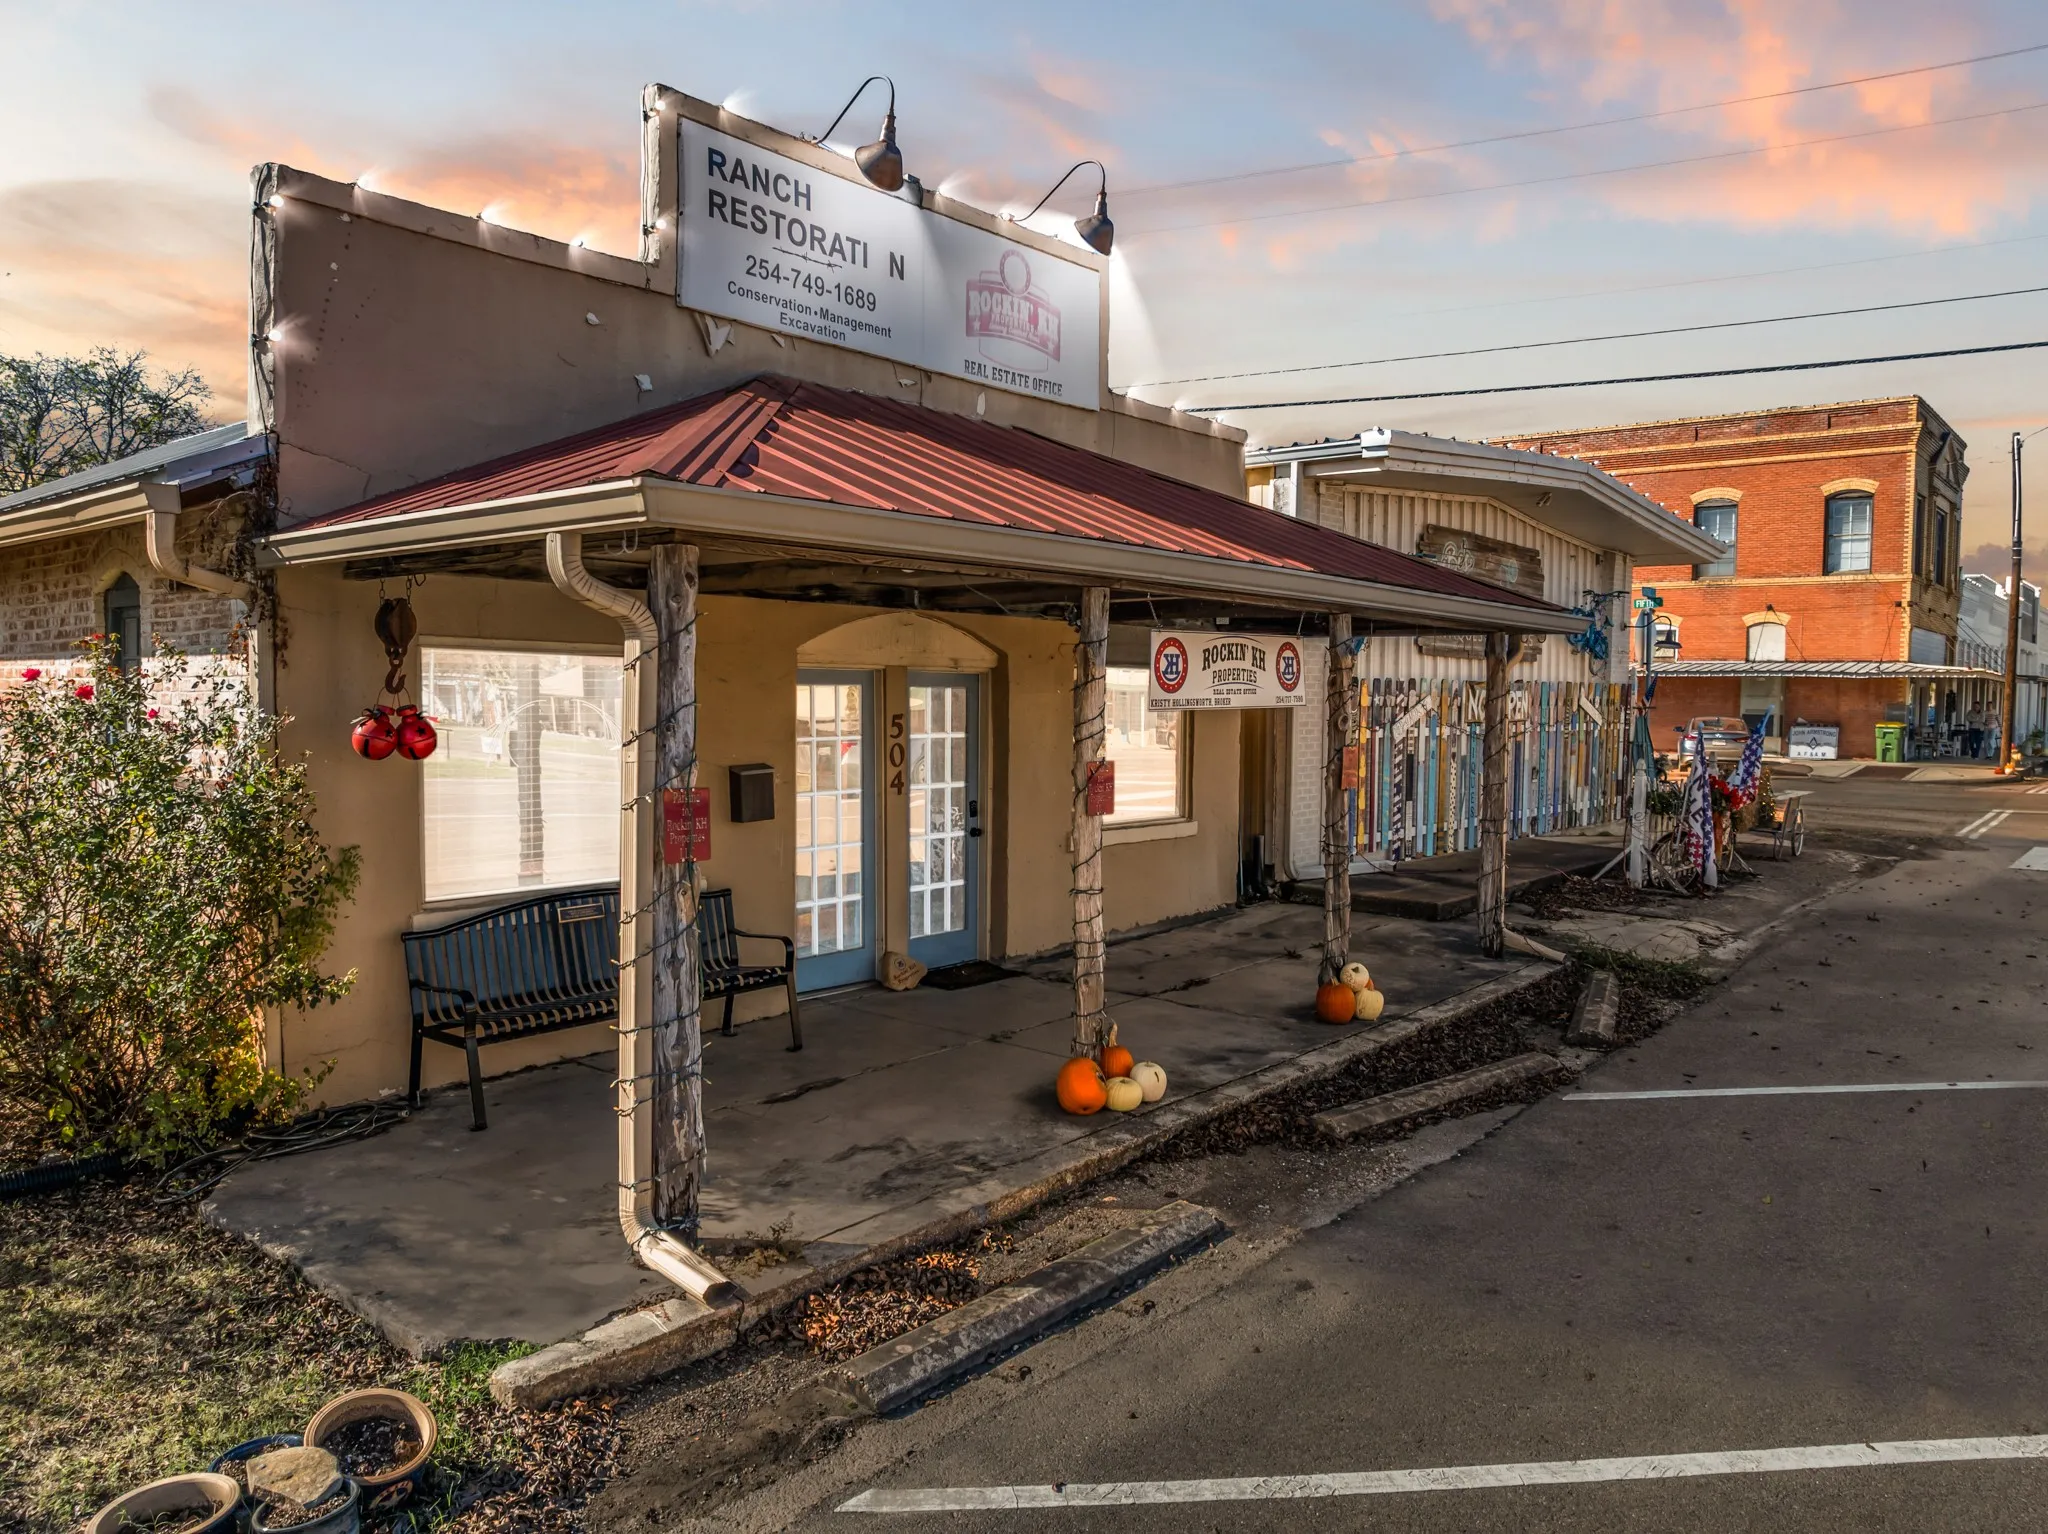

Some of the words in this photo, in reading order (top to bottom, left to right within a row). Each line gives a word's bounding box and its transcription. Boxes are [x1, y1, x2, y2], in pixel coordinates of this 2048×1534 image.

[707, 146, 811, 212] RANCH
[745, 254, 877, 312] 254-749-1689
[727, 280, 812, 316] Conservation
[819, 307, 892, 339] Management
[779, 312, 846, 341] Excavation
[964, 359, 989, 379] REAL
[992, 366, 1030, 390] ESTATE
[1032, 377, 1063, 397] OFFICE
[1202, 643, 1249, 671] ROCKIN'
[1251, 645, 1266, 672] KH
[1212, 668, 1258, 684] PROPERTIES
[1150, 698, 1171, 708] KRISTY
[1214, 697, 1232, 706] BROKER
[1507, 689, 1529, 721] PEN
[1807, 729, 1837, 738] ARMSTRONG
[889, 712, 905, 796] 504
